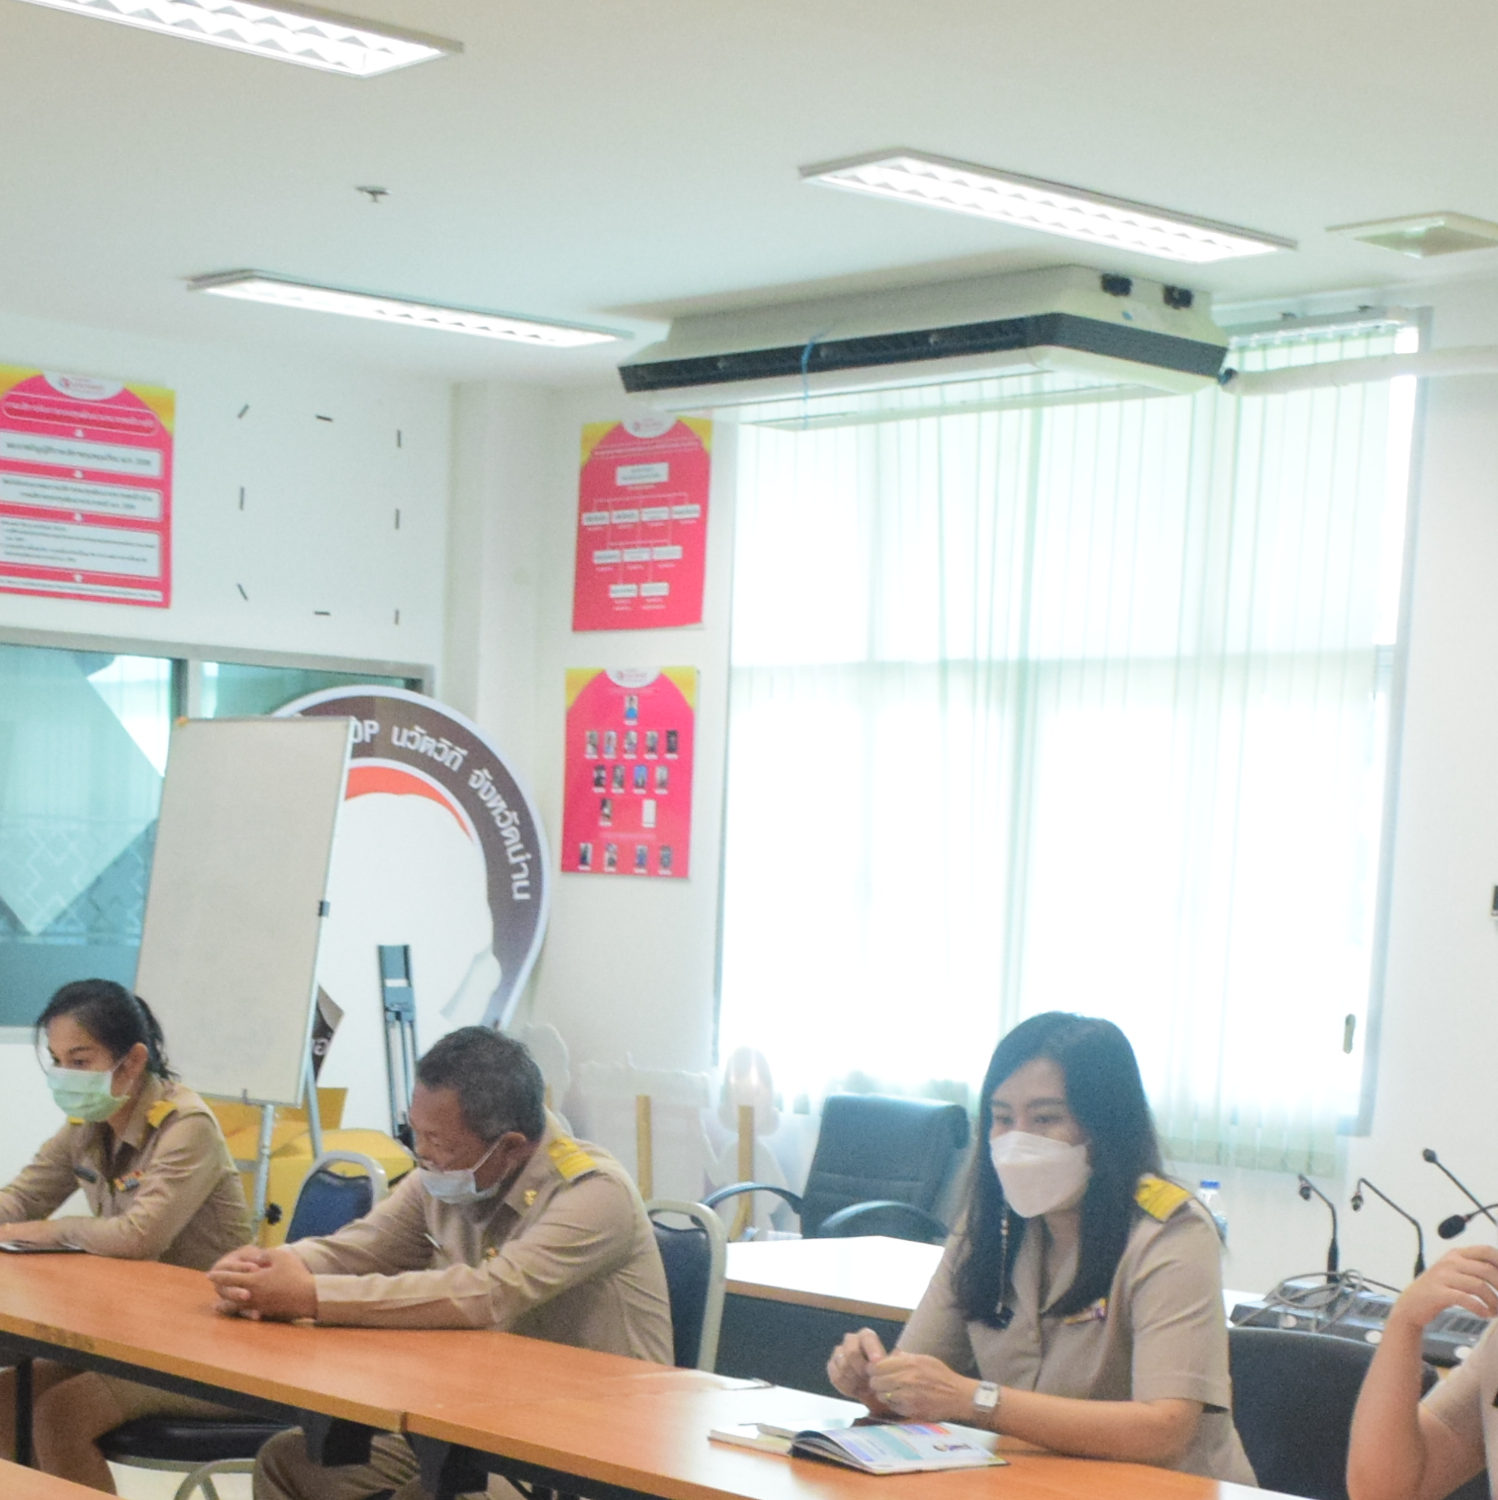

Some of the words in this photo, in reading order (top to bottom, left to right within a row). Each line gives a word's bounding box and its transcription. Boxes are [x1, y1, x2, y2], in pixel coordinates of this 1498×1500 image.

[391, 725, 468, 772] นวัตวิถี
[468, 767, 532, 900] จังหวัดน่าน
